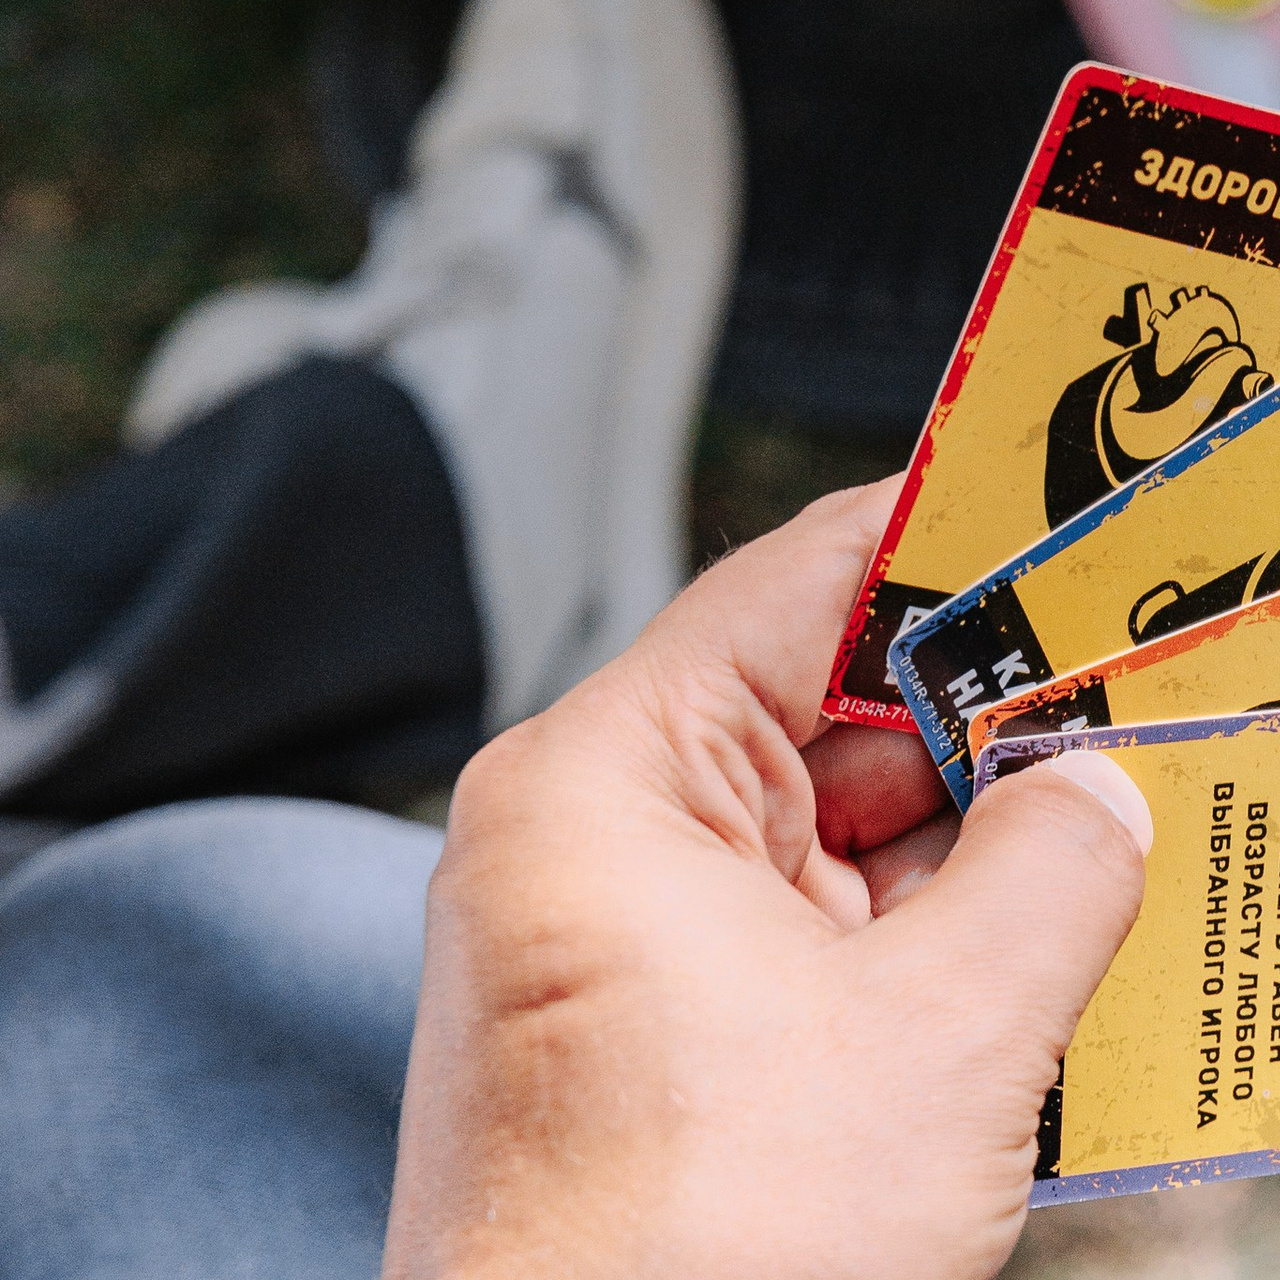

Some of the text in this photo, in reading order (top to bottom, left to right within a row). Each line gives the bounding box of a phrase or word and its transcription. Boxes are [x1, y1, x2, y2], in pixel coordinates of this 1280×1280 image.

[899, 656, 952, 750] 0134R-71-312
[1196, 781, 1235, 1130] ВЫБРАННОГО ИГРОКА
[1232, 801, 1269, 1101] ВОЗРАСТУ ЛЮБОГО
